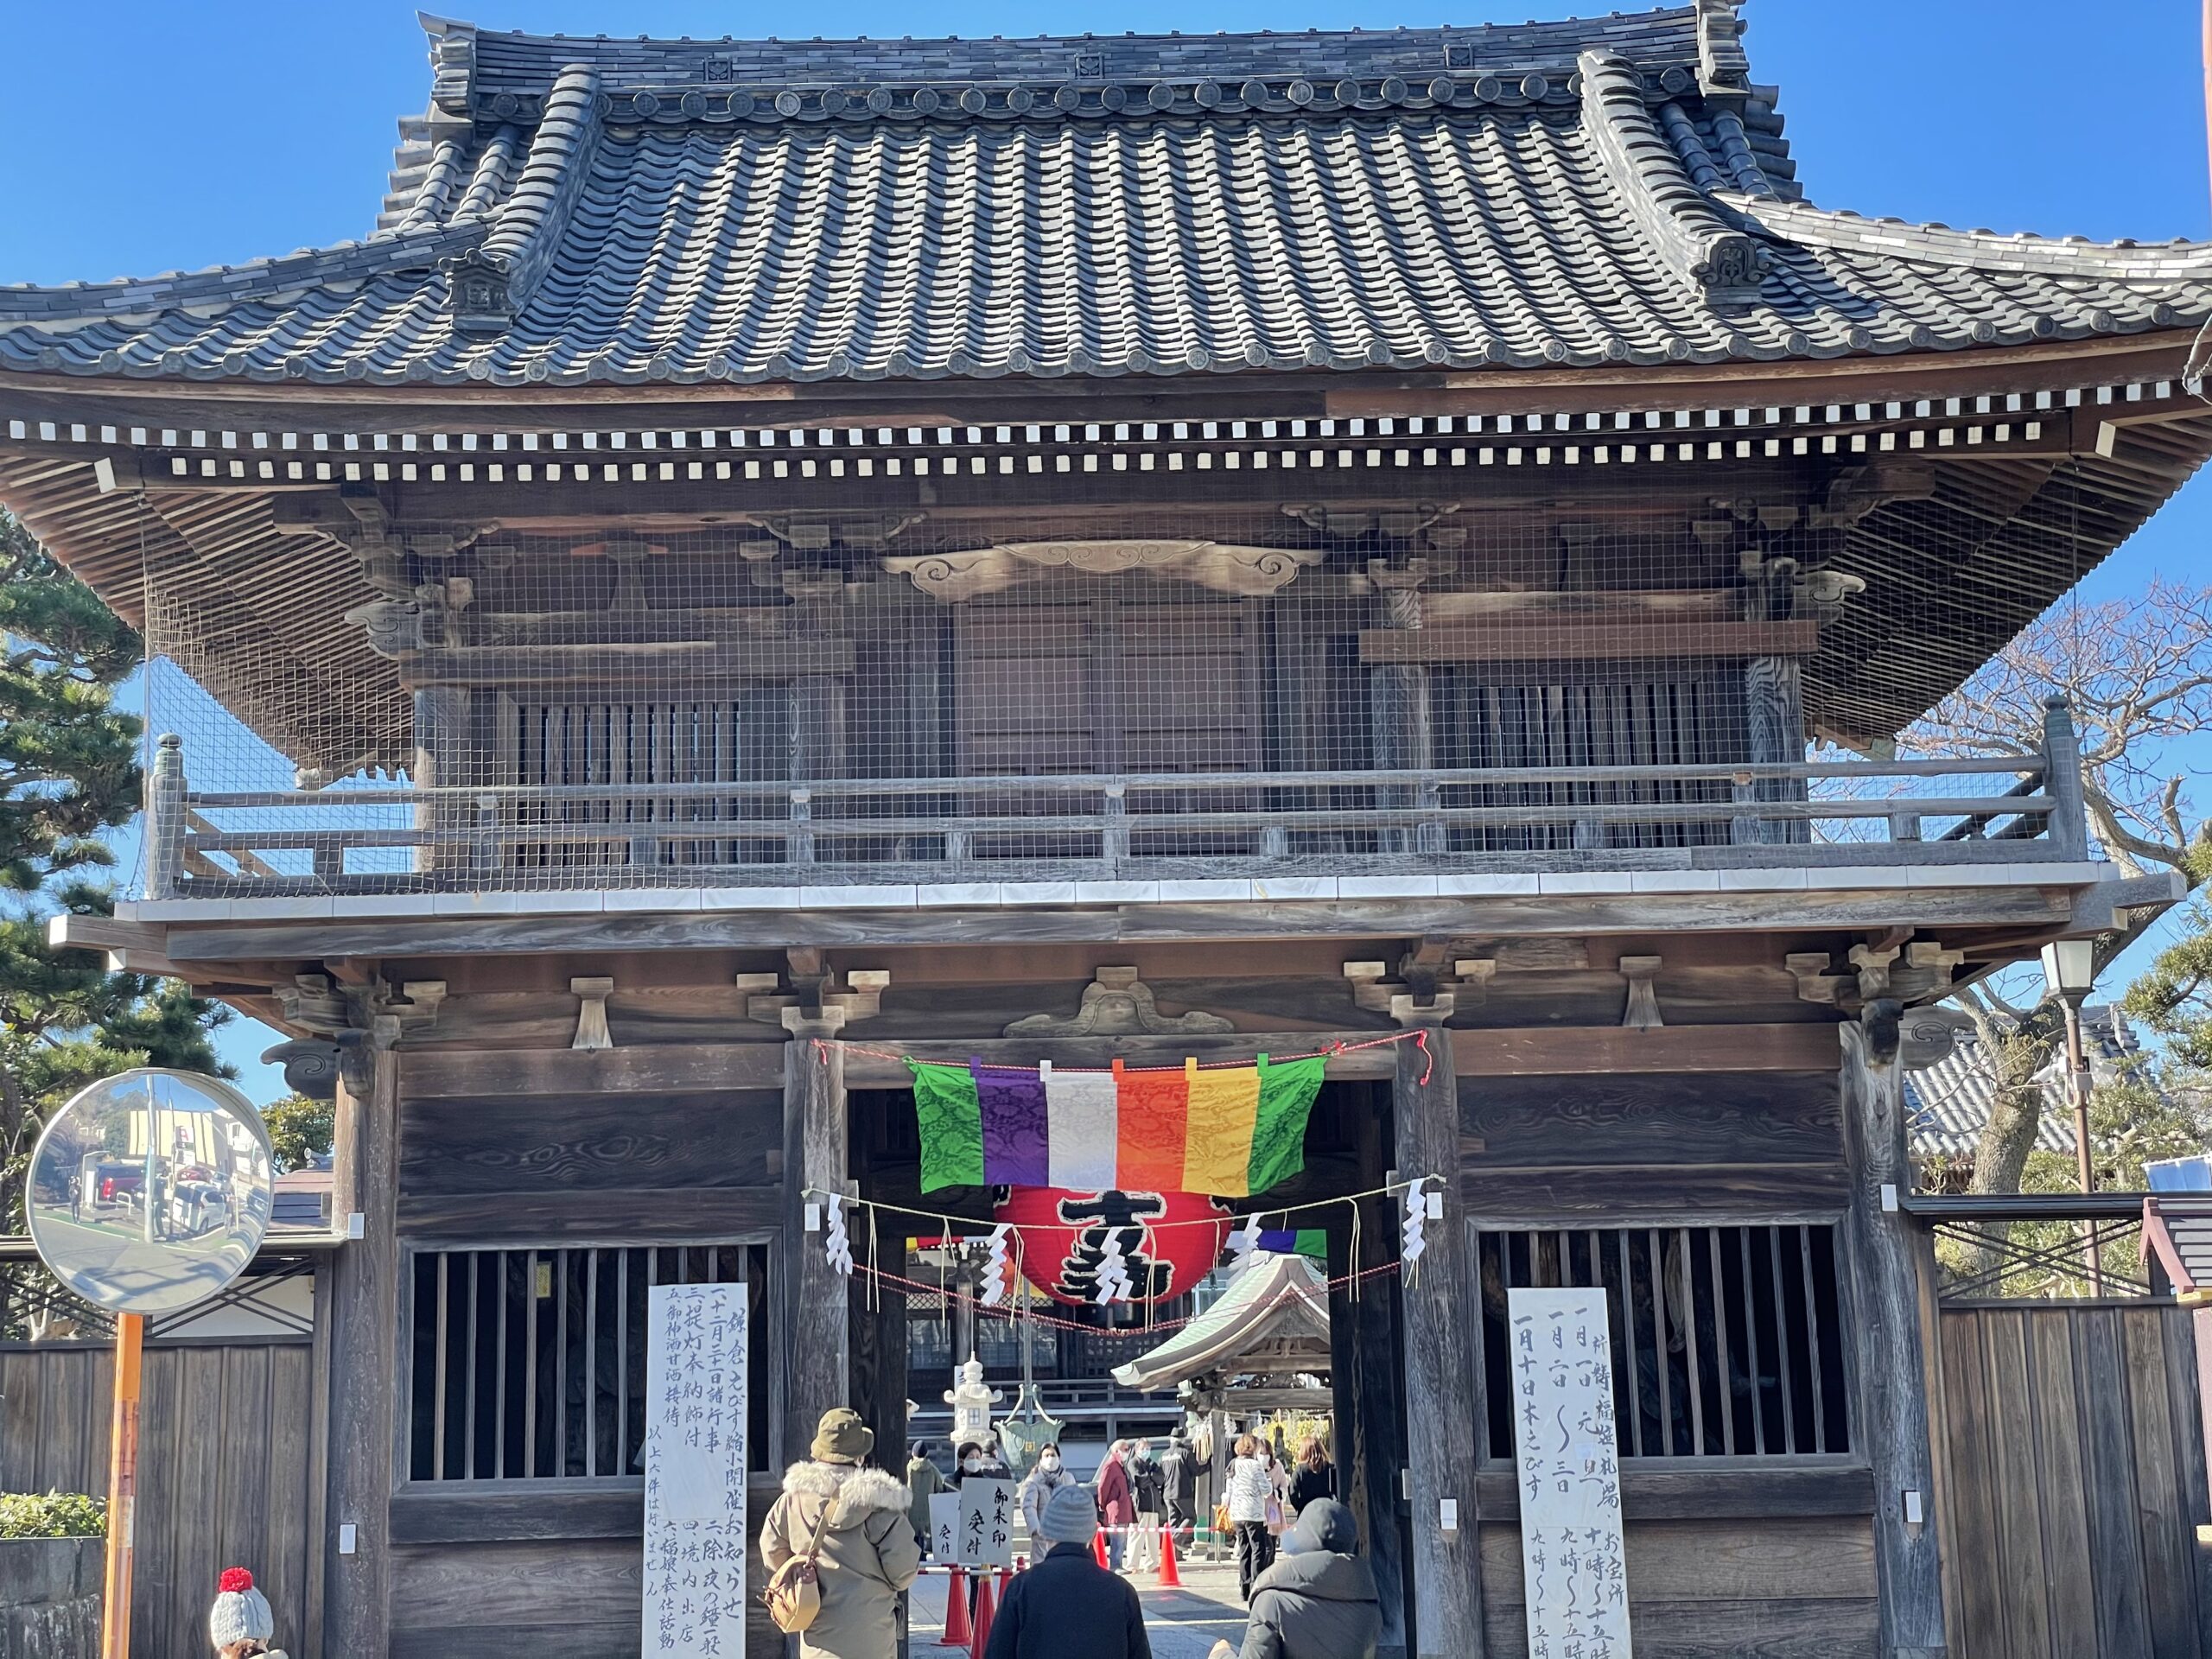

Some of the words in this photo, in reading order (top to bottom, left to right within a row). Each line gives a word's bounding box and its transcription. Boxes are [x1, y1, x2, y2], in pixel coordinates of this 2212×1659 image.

[966, 1509, 985, 1555] 受付
[992, 1485, 1009, 1548] 御朱印
